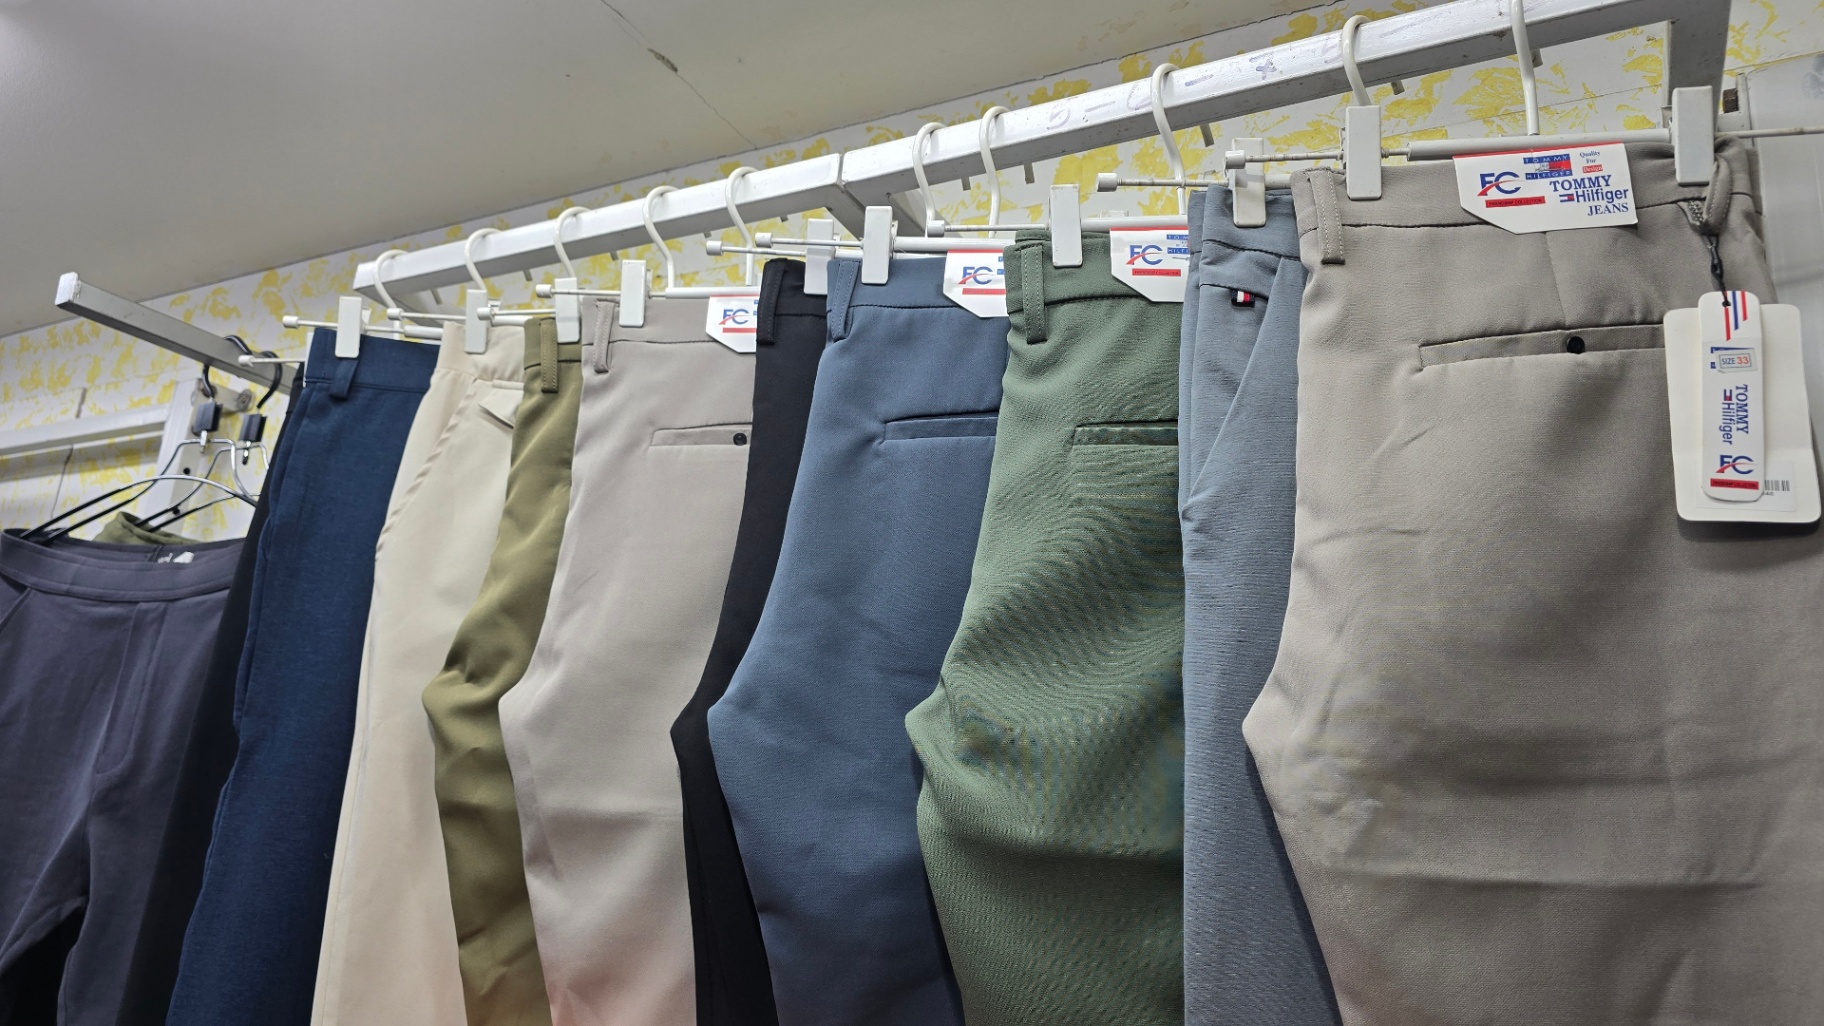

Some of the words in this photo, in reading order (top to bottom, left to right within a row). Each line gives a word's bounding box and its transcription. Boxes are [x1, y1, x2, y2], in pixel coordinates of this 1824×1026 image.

[1525, 155, 1568, 164] TOMMY
[1579, 150, 1601, 159] Quality
[1526, 171, 1571, 180] HILFIGER
[1583, 165, 1603, 173] Design
[1478, 171, 1522, 196] FC
[1549, 175, 1612, 192] TOMMY
[1575, 188, 1629, 204] Hilfiger
[1588, 202, 1629, 217] JEANS
[1126, 244, 1163, 265] FC
[958, 266, 993, 285] FC
[718, 309, 749, 325] FC
[1721, 357, 1736, 365] SIZE
[1736, 356, 1749, 365] 33
[1735, 384, 1749, 434] TOMMY
[1719, 402, 1736, 445] Hilfiger
[1716, 454, 1755, 475] FC
